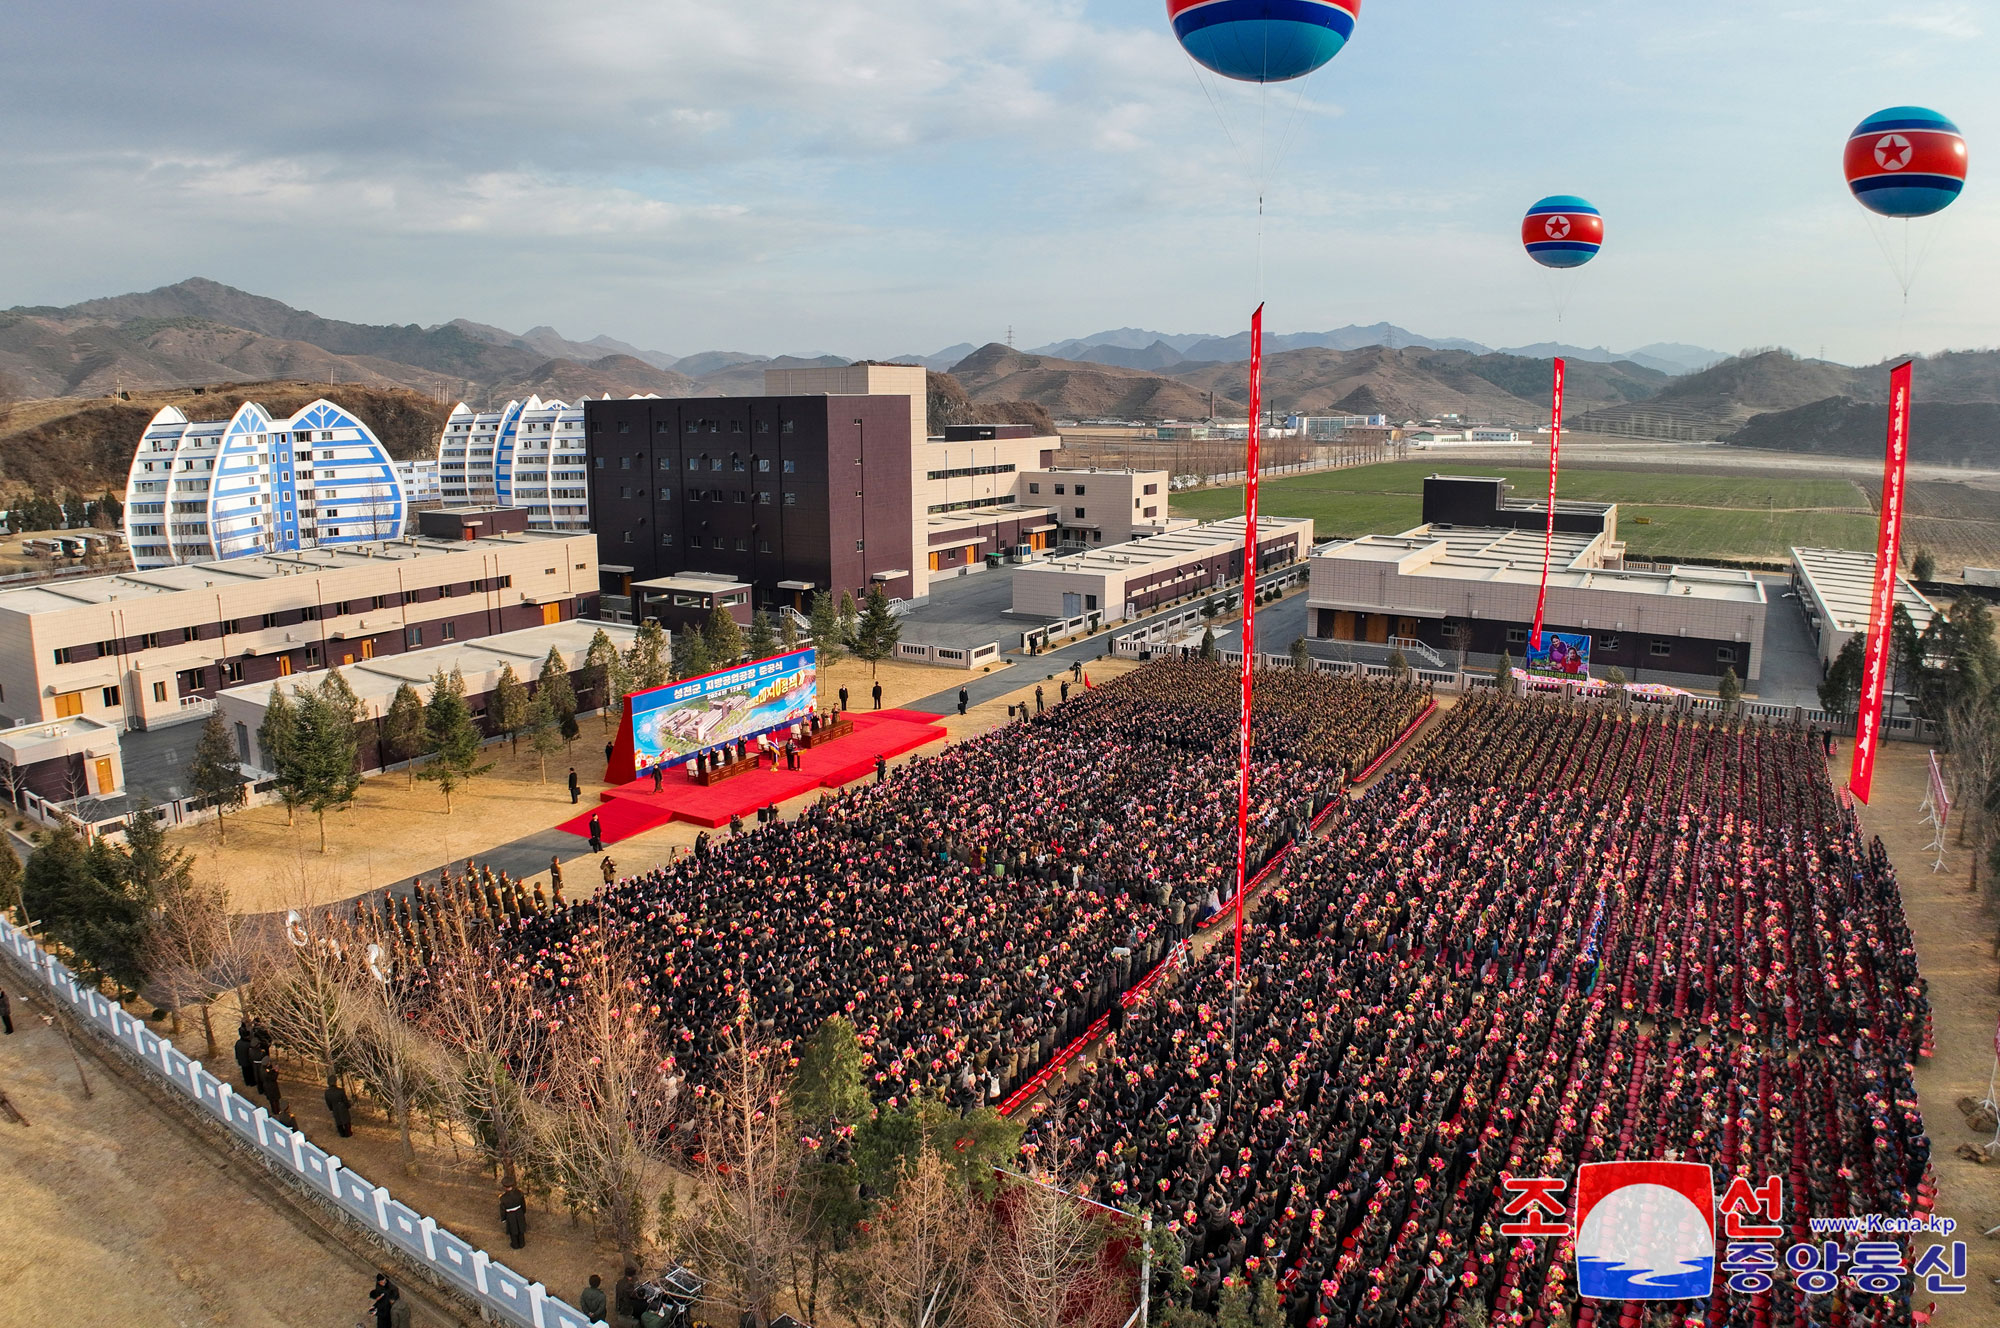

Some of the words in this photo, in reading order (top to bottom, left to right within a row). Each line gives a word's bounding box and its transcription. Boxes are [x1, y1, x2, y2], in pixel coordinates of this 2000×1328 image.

[1893, 387, 1904, 461] 위대한
[674, 683, 702, 700] 성천군
[705, 668, 756, 691] 지방공업공장
[759, 660, 783, 676] 준공식
[1859, 710, 1873, 777] 만세!
